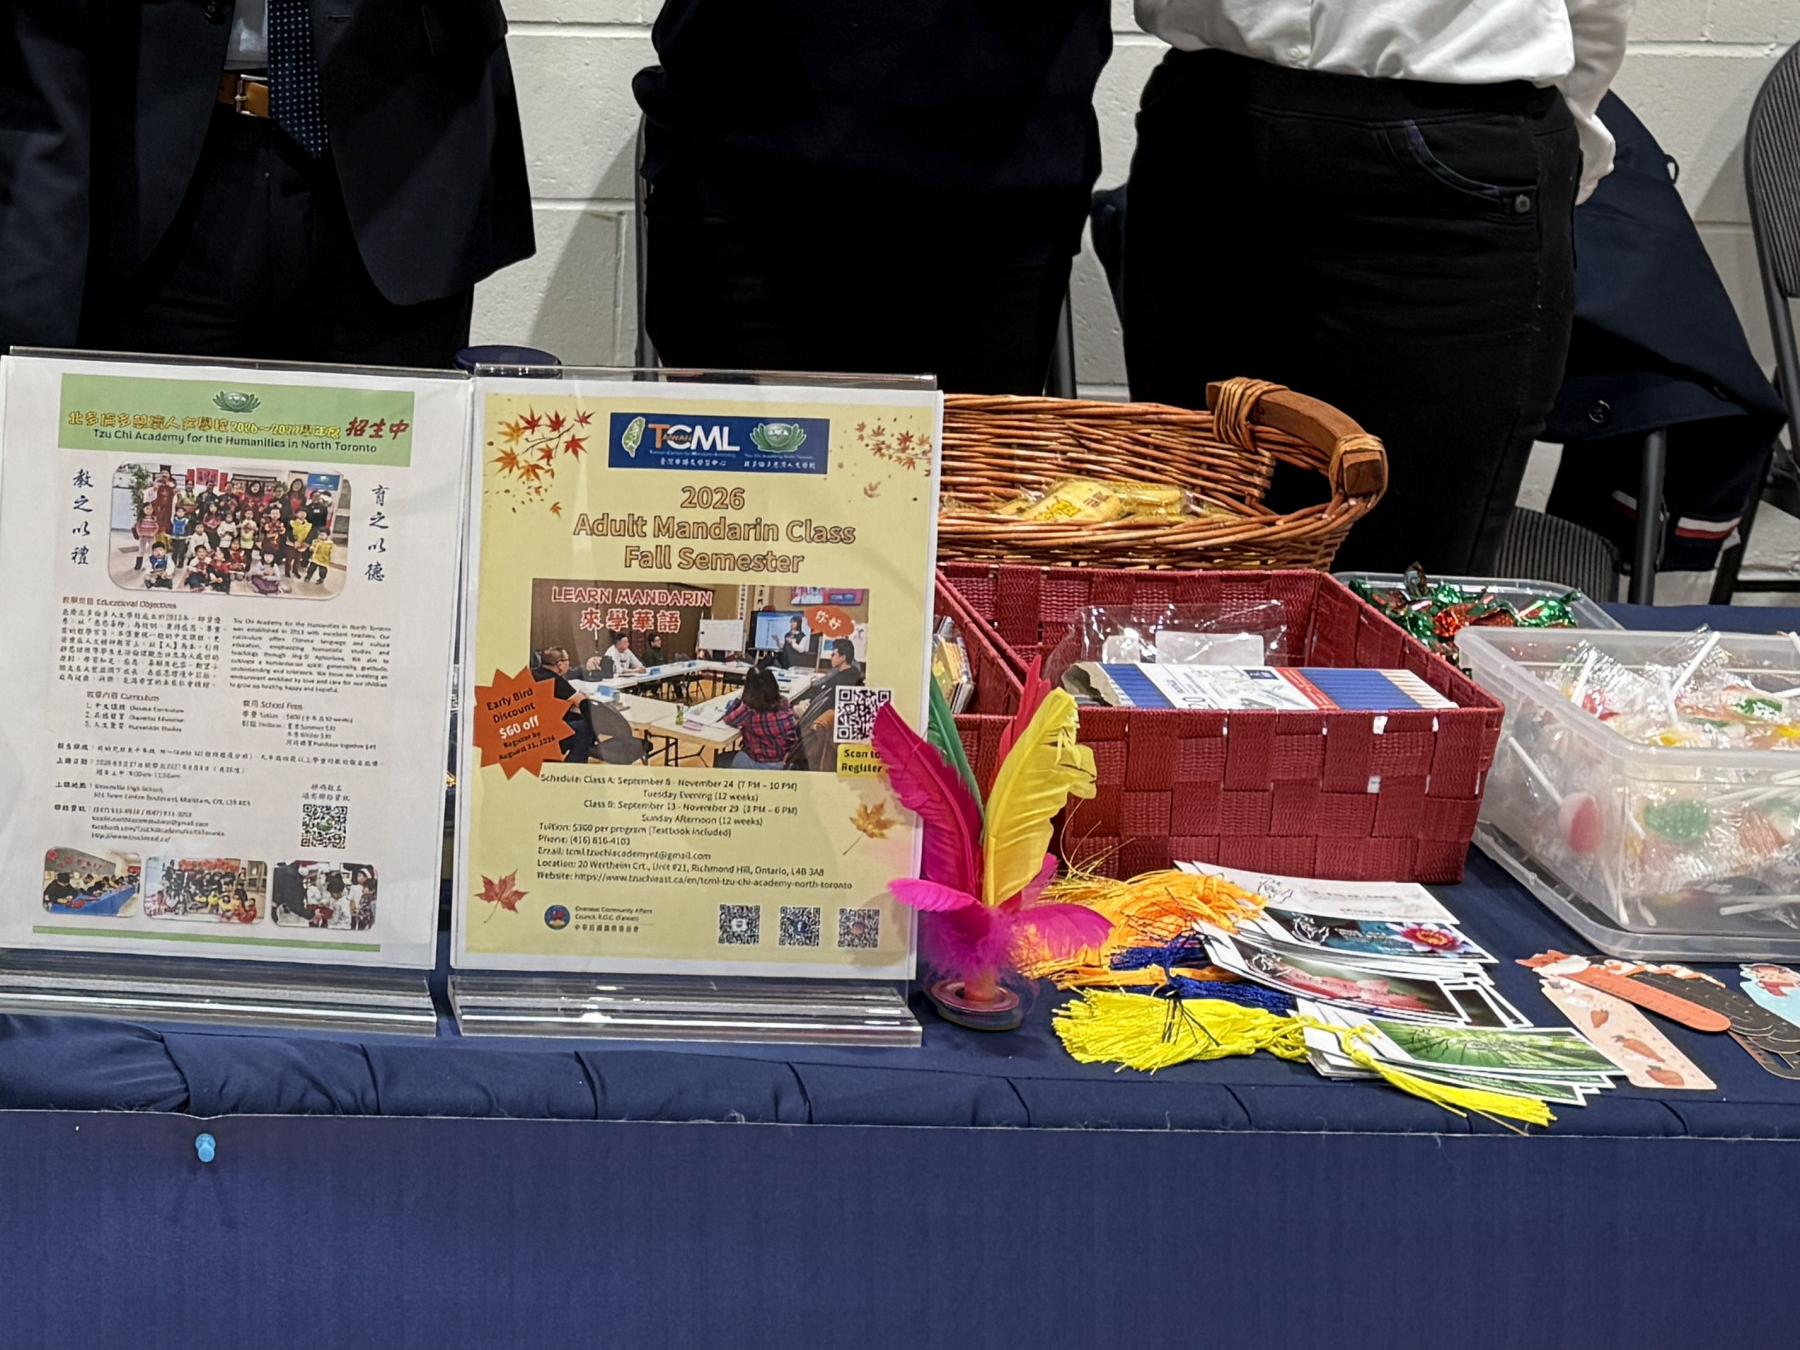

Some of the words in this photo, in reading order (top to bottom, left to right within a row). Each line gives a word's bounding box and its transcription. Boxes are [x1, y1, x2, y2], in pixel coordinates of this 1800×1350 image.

[93, 429, 111, 438] Tzu
[114, 430, 132, 439] Chi
[135, 431, 185, 445] Academy
[187, 433, 203, 442] for
[206, 435, 223, 444] the
[226, 436, 285, 448] Humanities
[288, 439, 298, 448] in
[301, 440, 331, 450] North
[335, 441, 377, 452] Toronto
[680, 486, 745, 510] 2026
[573, 512, 647, 538] Adult
[653, 515, 779, 543] Mandarin
[786, 518, 856, 545] Class
[624, 544, 672, 570] Fall
[677, 547, 805, 573] Semester
[551, 586, 613, 605] LEARN
[616, 588, 714, 607] MANDARIN
[580, 608, 682, 634] 來學華語
[486, 696, 512, 711] Early
[512, 688, 533, 702] Bird
[493, 702, 536, 724] Discount
[499, 723, 521, 740] $60
[522, 715, 540, 730] off
[844, 749, 868, 759] Scan
